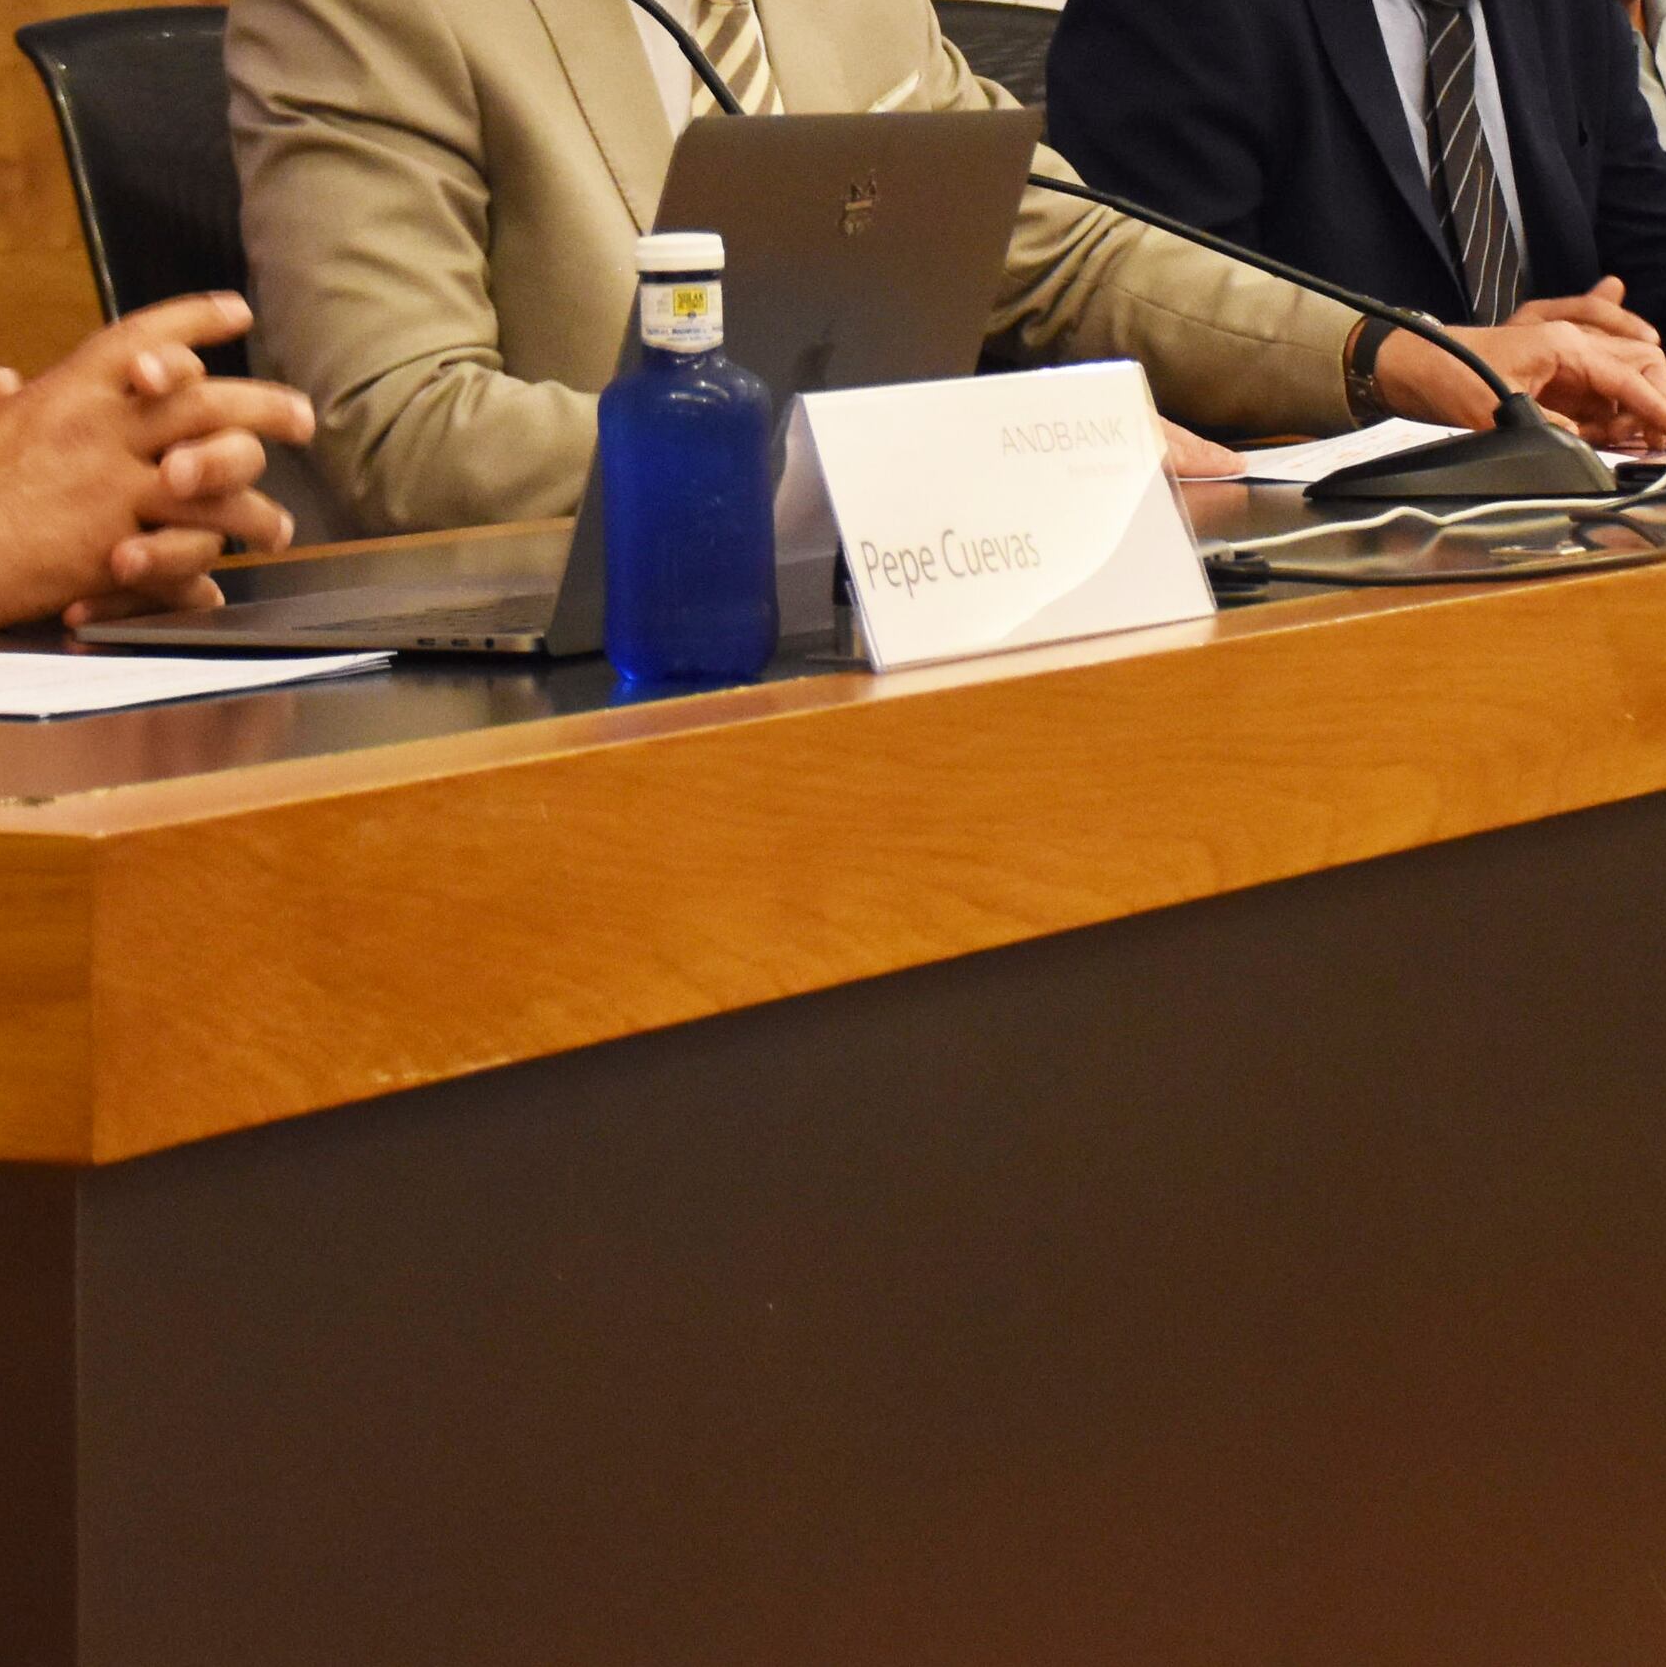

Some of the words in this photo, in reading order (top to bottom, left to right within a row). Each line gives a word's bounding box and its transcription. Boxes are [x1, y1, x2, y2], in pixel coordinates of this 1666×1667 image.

[1002, 417, 1129, 456] ANDBANK
[860, 540, 937, 599] Pepe
[941, 529, 1041, 579] Cuevas
